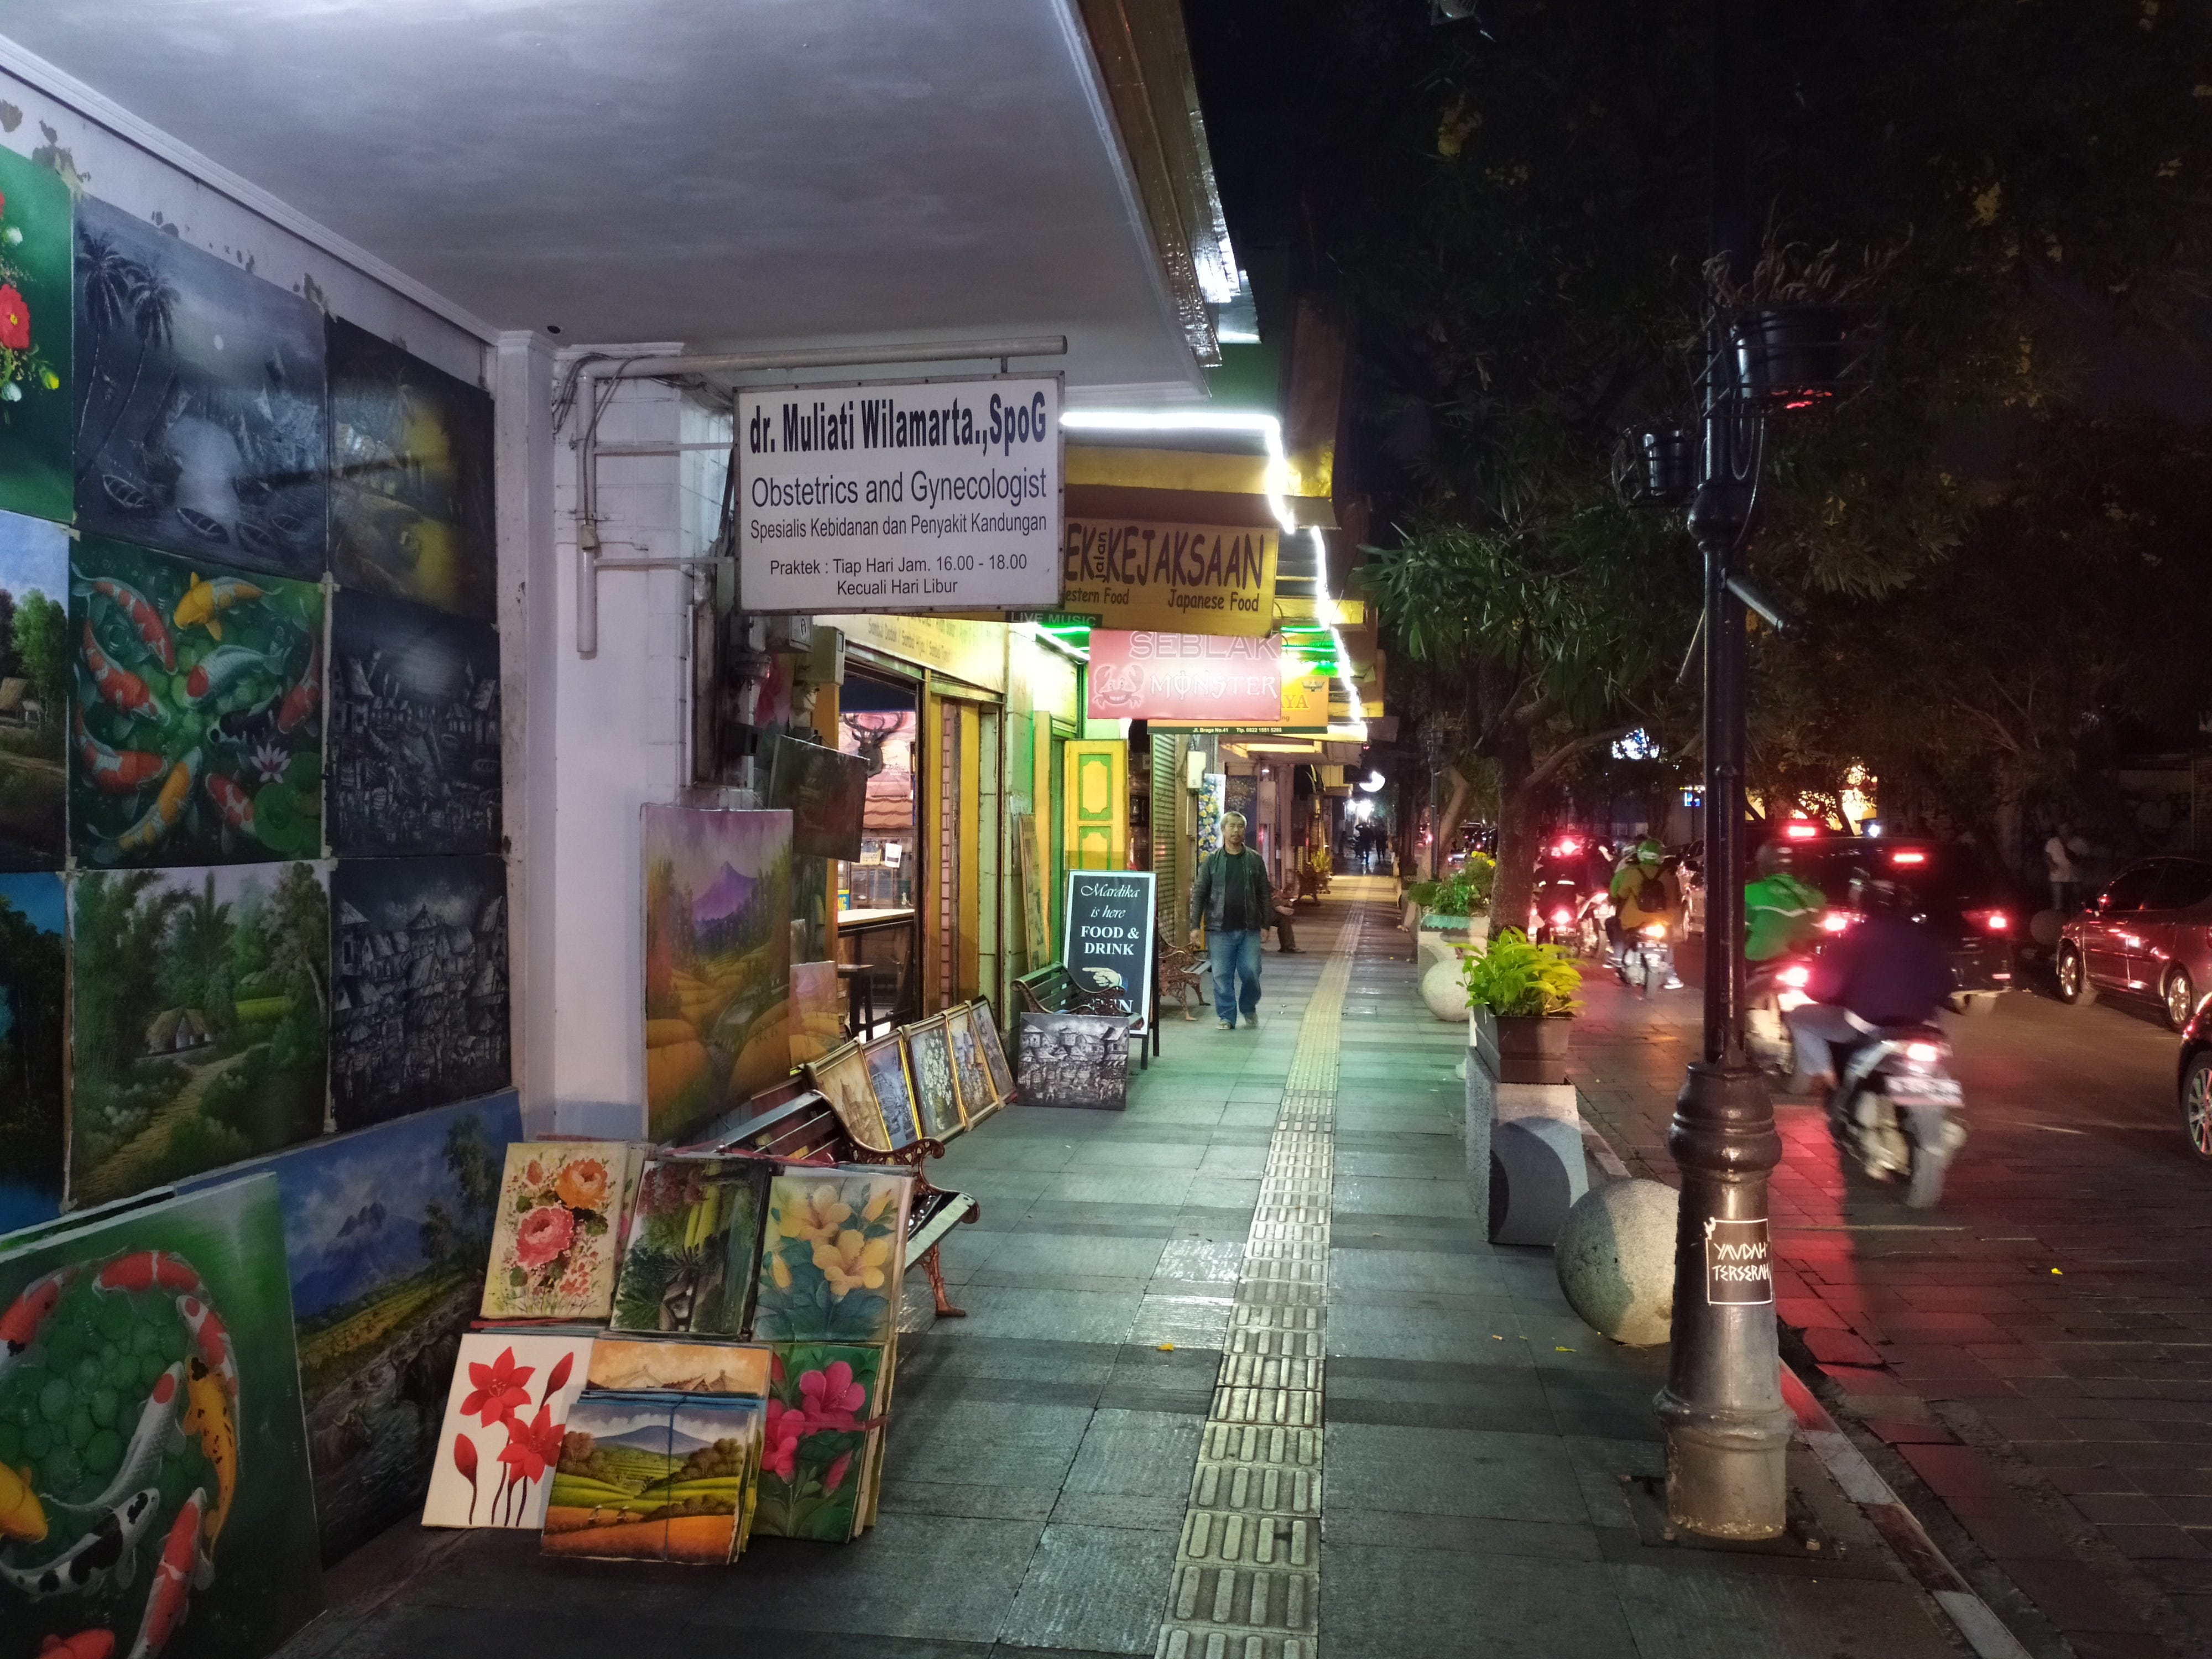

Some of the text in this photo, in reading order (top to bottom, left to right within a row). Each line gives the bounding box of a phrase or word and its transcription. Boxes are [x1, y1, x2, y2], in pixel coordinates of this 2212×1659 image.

[750, 405, 775, 454] dr.
[783, 400, 854, 452] Muliati
[752, 467, 1047, 510] Obstetrics and Gynecologist
[750, 512, 1047, 543] Spesialis Kebidanan dan Penyakit Kandungan
[770, 560, 821, 575] Praktek
[833, 558, 862, 576] Tiap
[866, 557, 894, 573] Hari
[898, 557, 931, 572] Jam.
[936, 555, 974, 571] 16.00
[989, 554, 1027, 570] 18.00
[1064, 523, 1264, 590] EK Jalan KEJAKSAAN
[837, 578, 958, 595] Kecuali Hari Libur
[1065, 587, 1129, 605] estern Food
[1167, 589, 1260, 614] Japanese Food
[1011, 612, 1097, 627] LIVE MUSIC
[1129, 629, 1281, 660] SEBLAK
[1282, 694, 1310, 709] YA
[1081, 883, 1140, 898] Mardika
[1091, 905, 1126, 919] is here
[1081, 926, 1140, 940] FOOD &
[1084, 942, 1135, 956] DRINK
